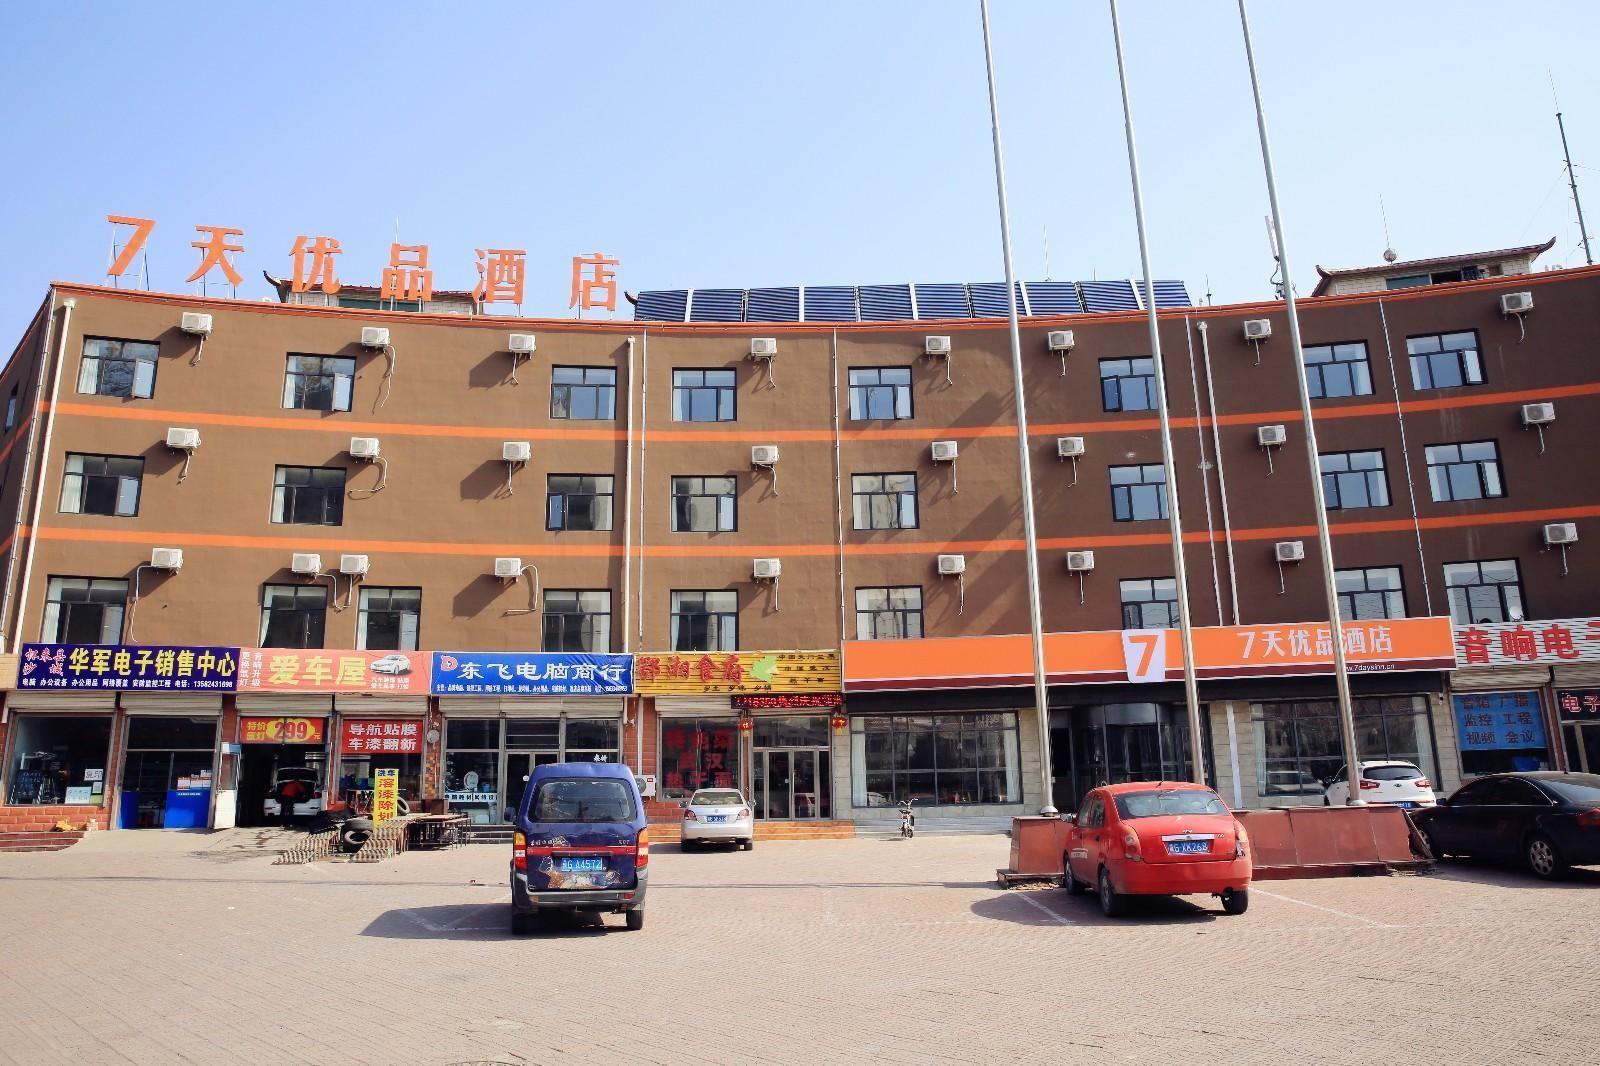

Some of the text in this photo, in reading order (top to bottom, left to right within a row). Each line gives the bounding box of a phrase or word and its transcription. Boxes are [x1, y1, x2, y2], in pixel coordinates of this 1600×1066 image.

[107, 214, 620, 312] 7天优品酒店
[1236, 626, 1393, 658] 7天优品酒店
[69, 647, 236, 677] 华军电子销售中心
[1128, 635, 1160, 676] 7
[268, 655, 366, 686] 爱车屋
[456, 662, 626, 680] 东飞电脑商行
[71, 679, 98, 687] 办公用品
[1503, 711, 1534, 725] 工程
[247, 721, 308, 740] 特价 299
[348, 723, 417, 736] 导航贴膜
[1466, 729, 1535, 745] 视频 会议
[348, 738, 417, 751] 车漆翻新
